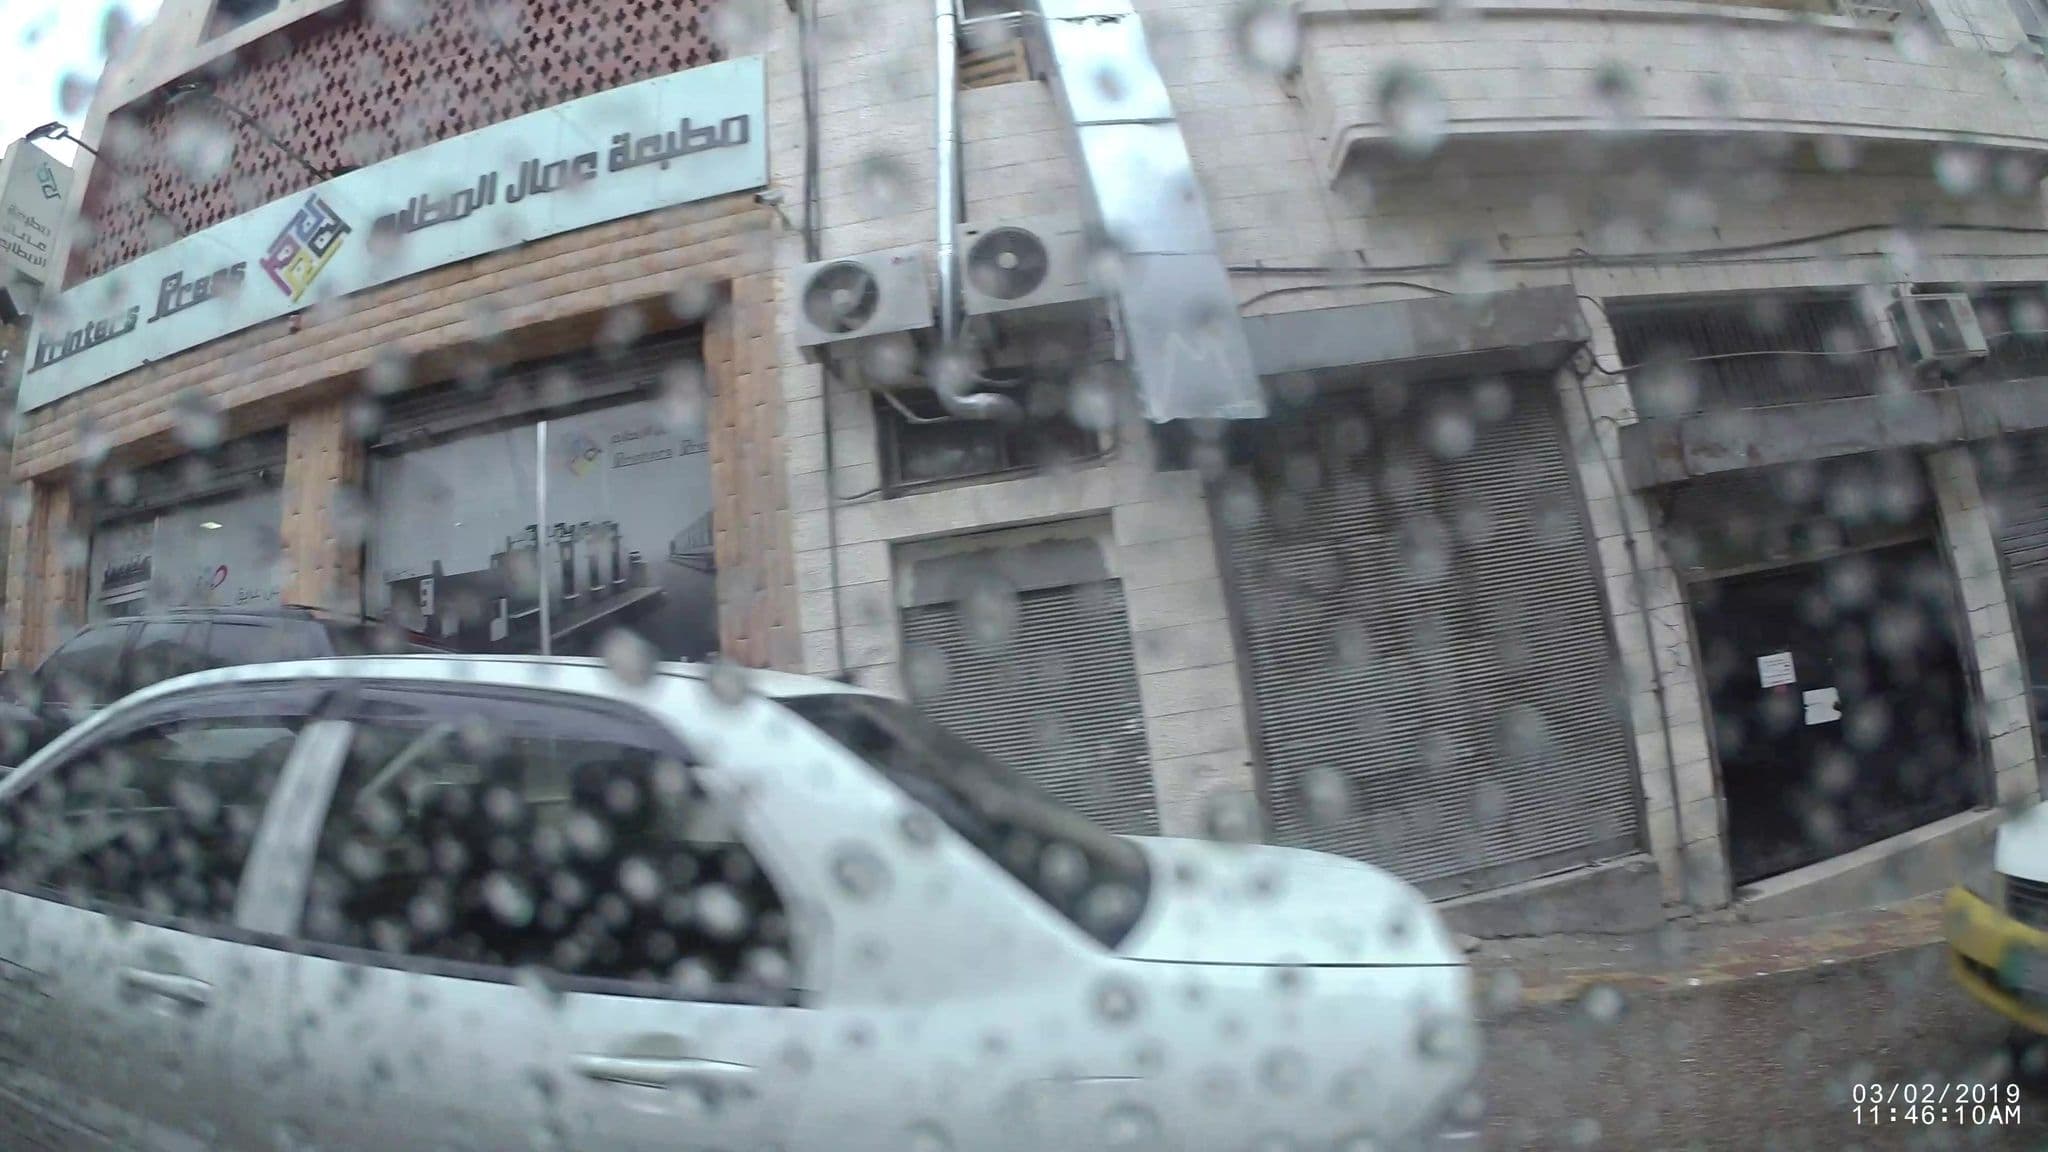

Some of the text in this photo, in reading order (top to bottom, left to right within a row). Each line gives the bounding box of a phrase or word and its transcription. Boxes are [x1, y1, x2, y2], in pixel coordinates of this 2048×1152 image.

[371, 113, 750, 237] مطبعة عمال المطا
